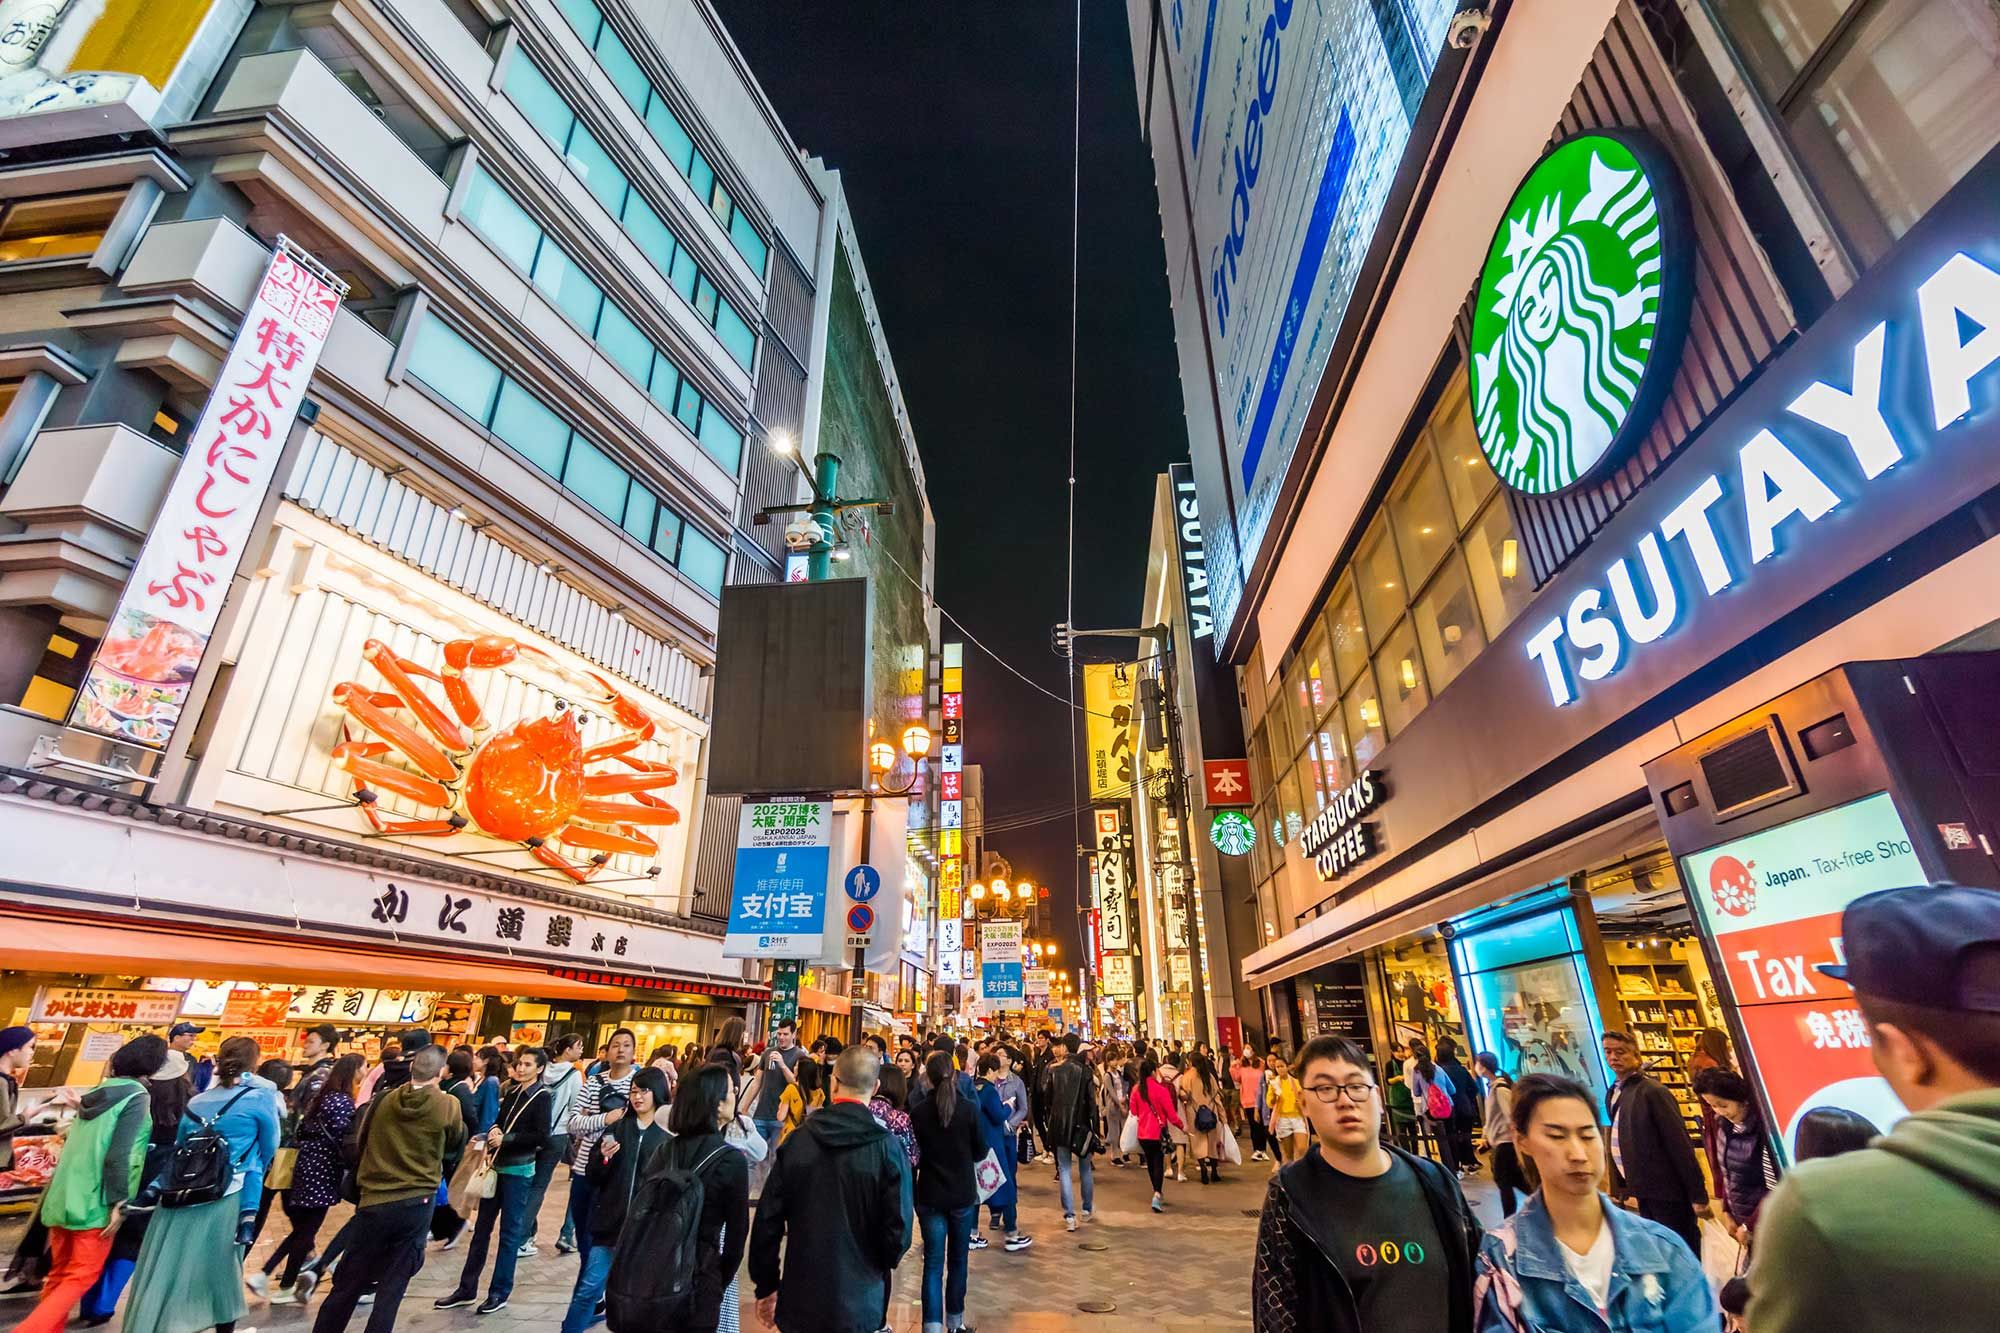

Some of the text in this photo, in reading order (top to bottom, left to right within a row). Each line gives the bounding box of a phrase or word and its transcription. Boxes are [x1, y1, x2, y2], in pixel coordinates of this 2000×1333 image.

[148, 317, 305, 612] 特大かにしゃぶ
[1526, 252, 2000, 708] TSUTAYA
[1212, 768, 1243, 796] 本
[752, 816, 820, 828] 大阪・関西へ
[753, 804, 820, 816] 2025万博を
[1300, 770, 1373, 859] STARBUCKS
[765, 828, 806, 836] EXPO2025
[1315, 823, 1366, 881] COFFEE
[1765, 865, 1811, 888] Japan.
[1812, 849, 1875, 877] Tax-free
[757, 878, 804, 891] 推荐使用
[1102, 833, 1122, 940] がんこ寿司
[740, 892, 814, 918] 支付宝
[986, 981, 1018, 992] 支付宝
[1804, 1010, 1872, 1049] 免税
